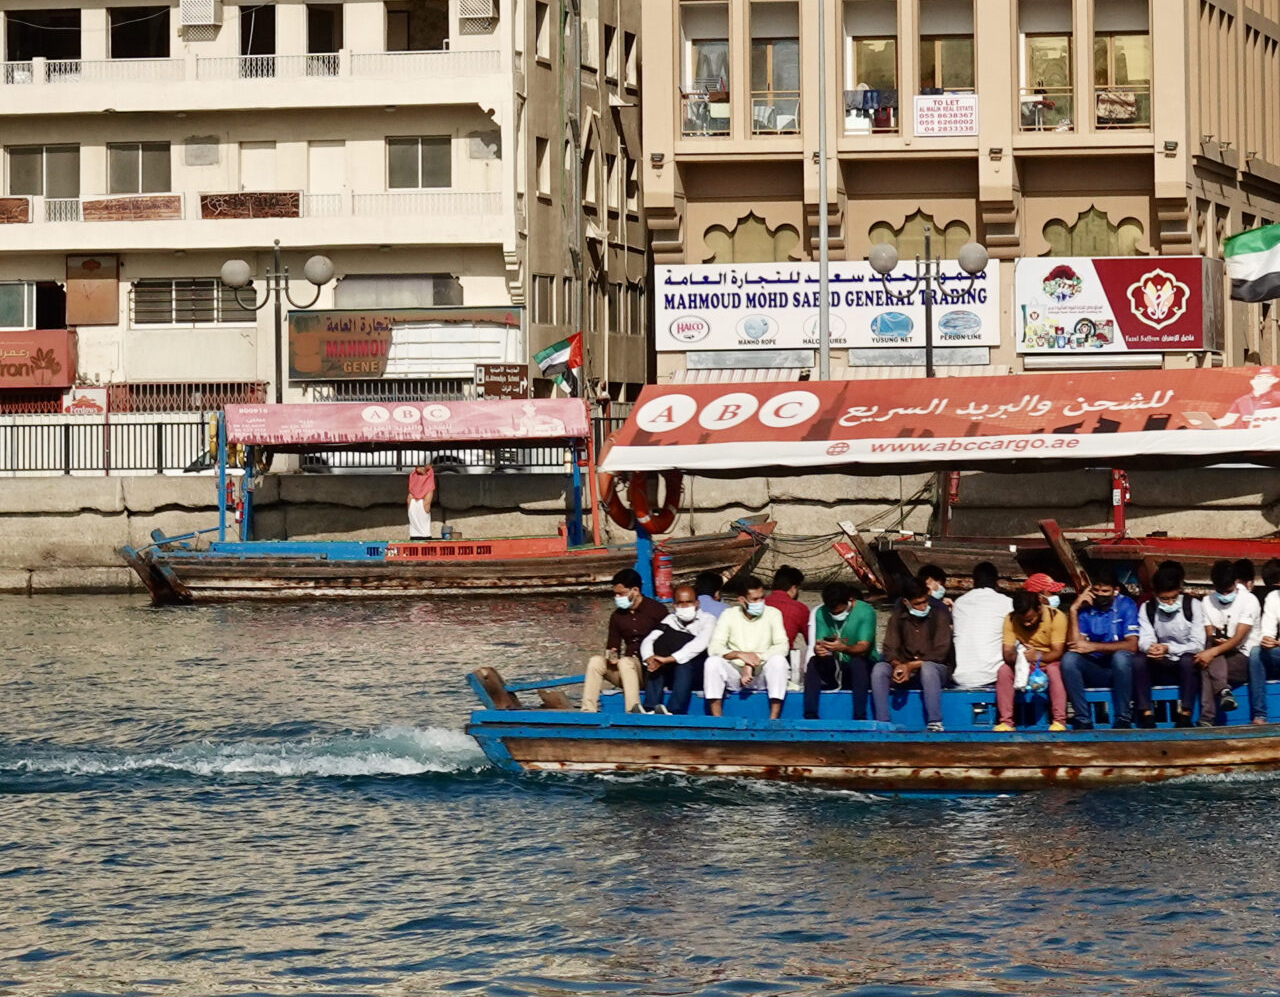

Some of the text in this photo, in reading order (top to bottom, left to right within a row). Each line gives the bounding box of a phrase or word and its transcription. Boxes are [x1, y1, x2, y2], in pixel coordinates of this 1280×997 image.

[664, 269, 727, 285] العامة
[731, 270, 801, 288] للتجارة
[664, 288, 988, 309] MAHMOUD MOHD SAED GENERAL TRADING
[326, 316, 356, 332] العامة
[677, 323, 704, 334] HALCO
[344, 361, 381, 372] GENE
[838, 390, 1174, 426] للشحن والبريد السريع
[870, 436, 1080, 453] www.abccargo.ae
